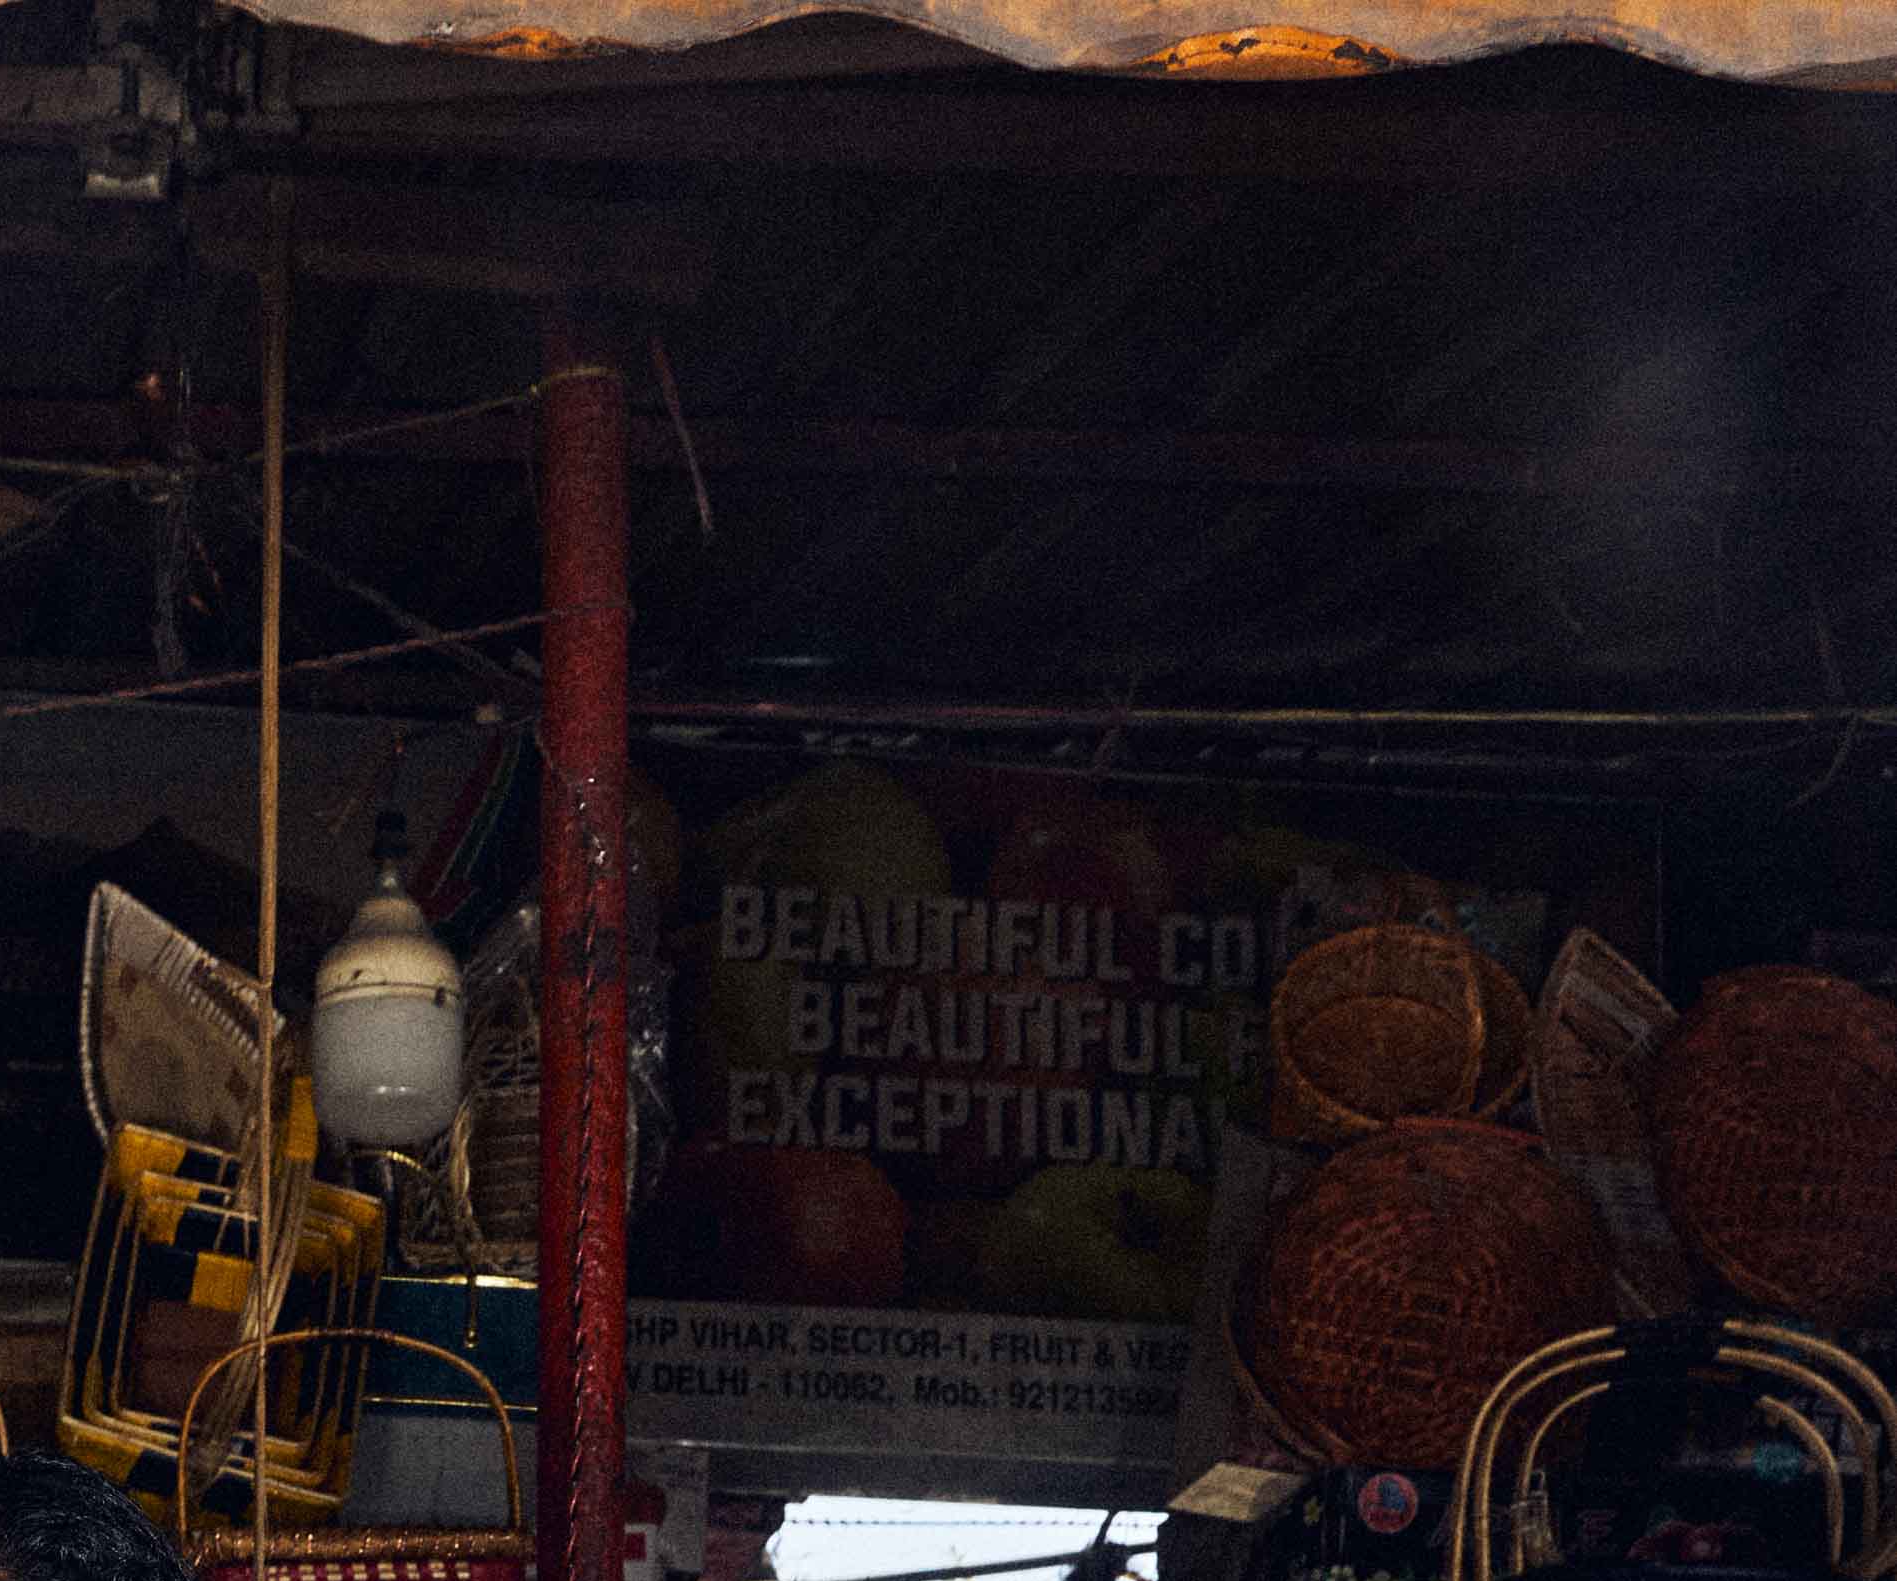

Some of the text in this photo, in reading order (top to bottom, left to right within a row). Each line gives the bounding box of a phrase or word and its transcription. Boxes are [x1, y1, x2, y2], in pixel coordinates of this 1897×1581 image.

[720, 883, 1258, 989] BEAUTIFUL CO
[789, 979, 1203, 1078] BEAUTIFUL
[653, 1365, 749, 1397] DELHI
[809, 1327, 981, 1363] SECTOR-1,
[989, 1334, 1082, 1365] FRUIT
[1095, 1341, 1114, 1368] &
